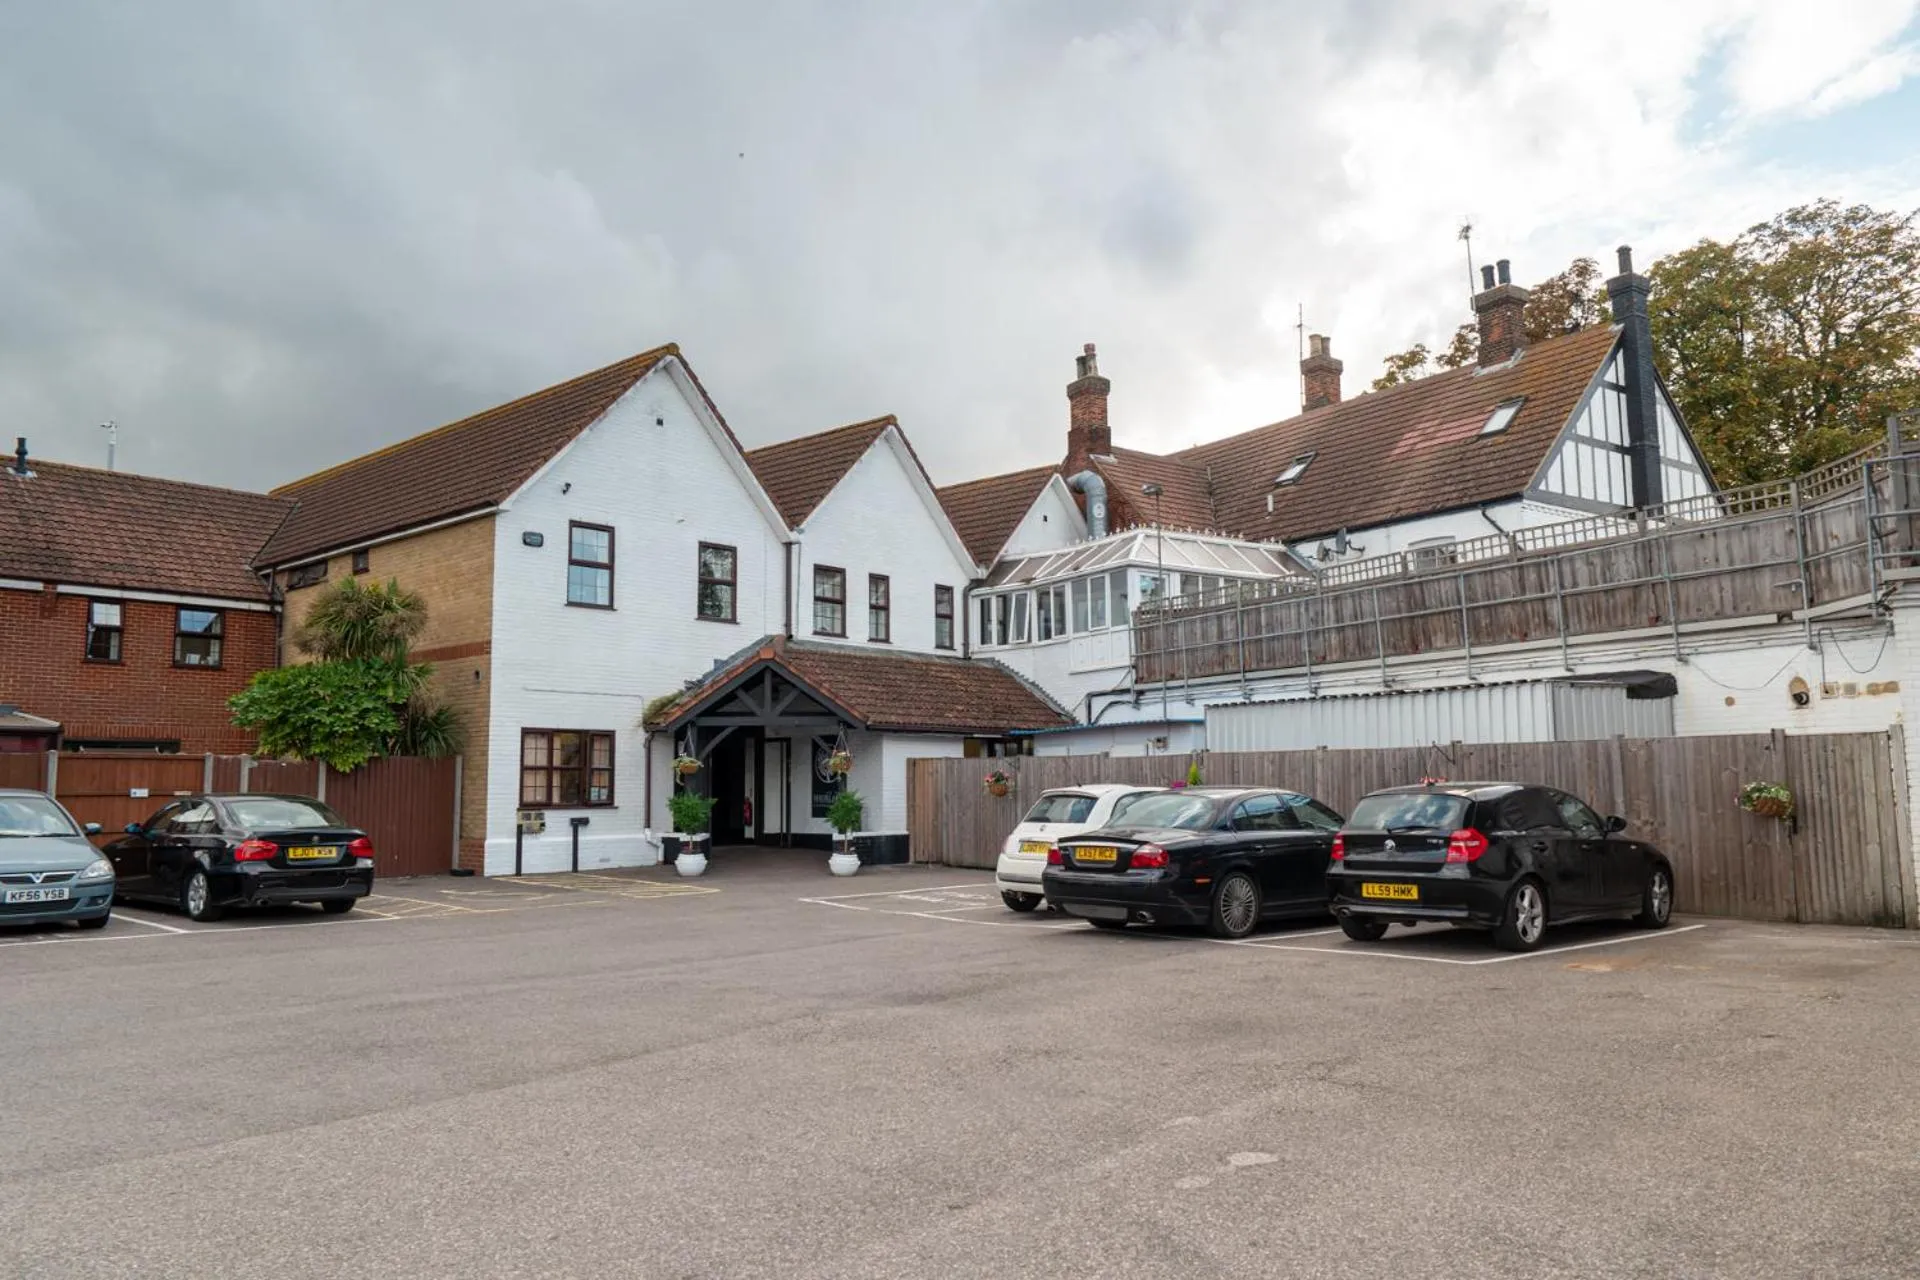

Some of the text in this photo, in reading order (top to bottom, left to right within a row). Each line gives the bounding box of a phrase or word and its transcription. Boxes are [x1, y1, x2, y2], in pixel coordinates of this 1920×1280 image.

[10, 889, 65, 901] KF56 YSB
[1366, 884, 1414, 897] LL59 HMK
